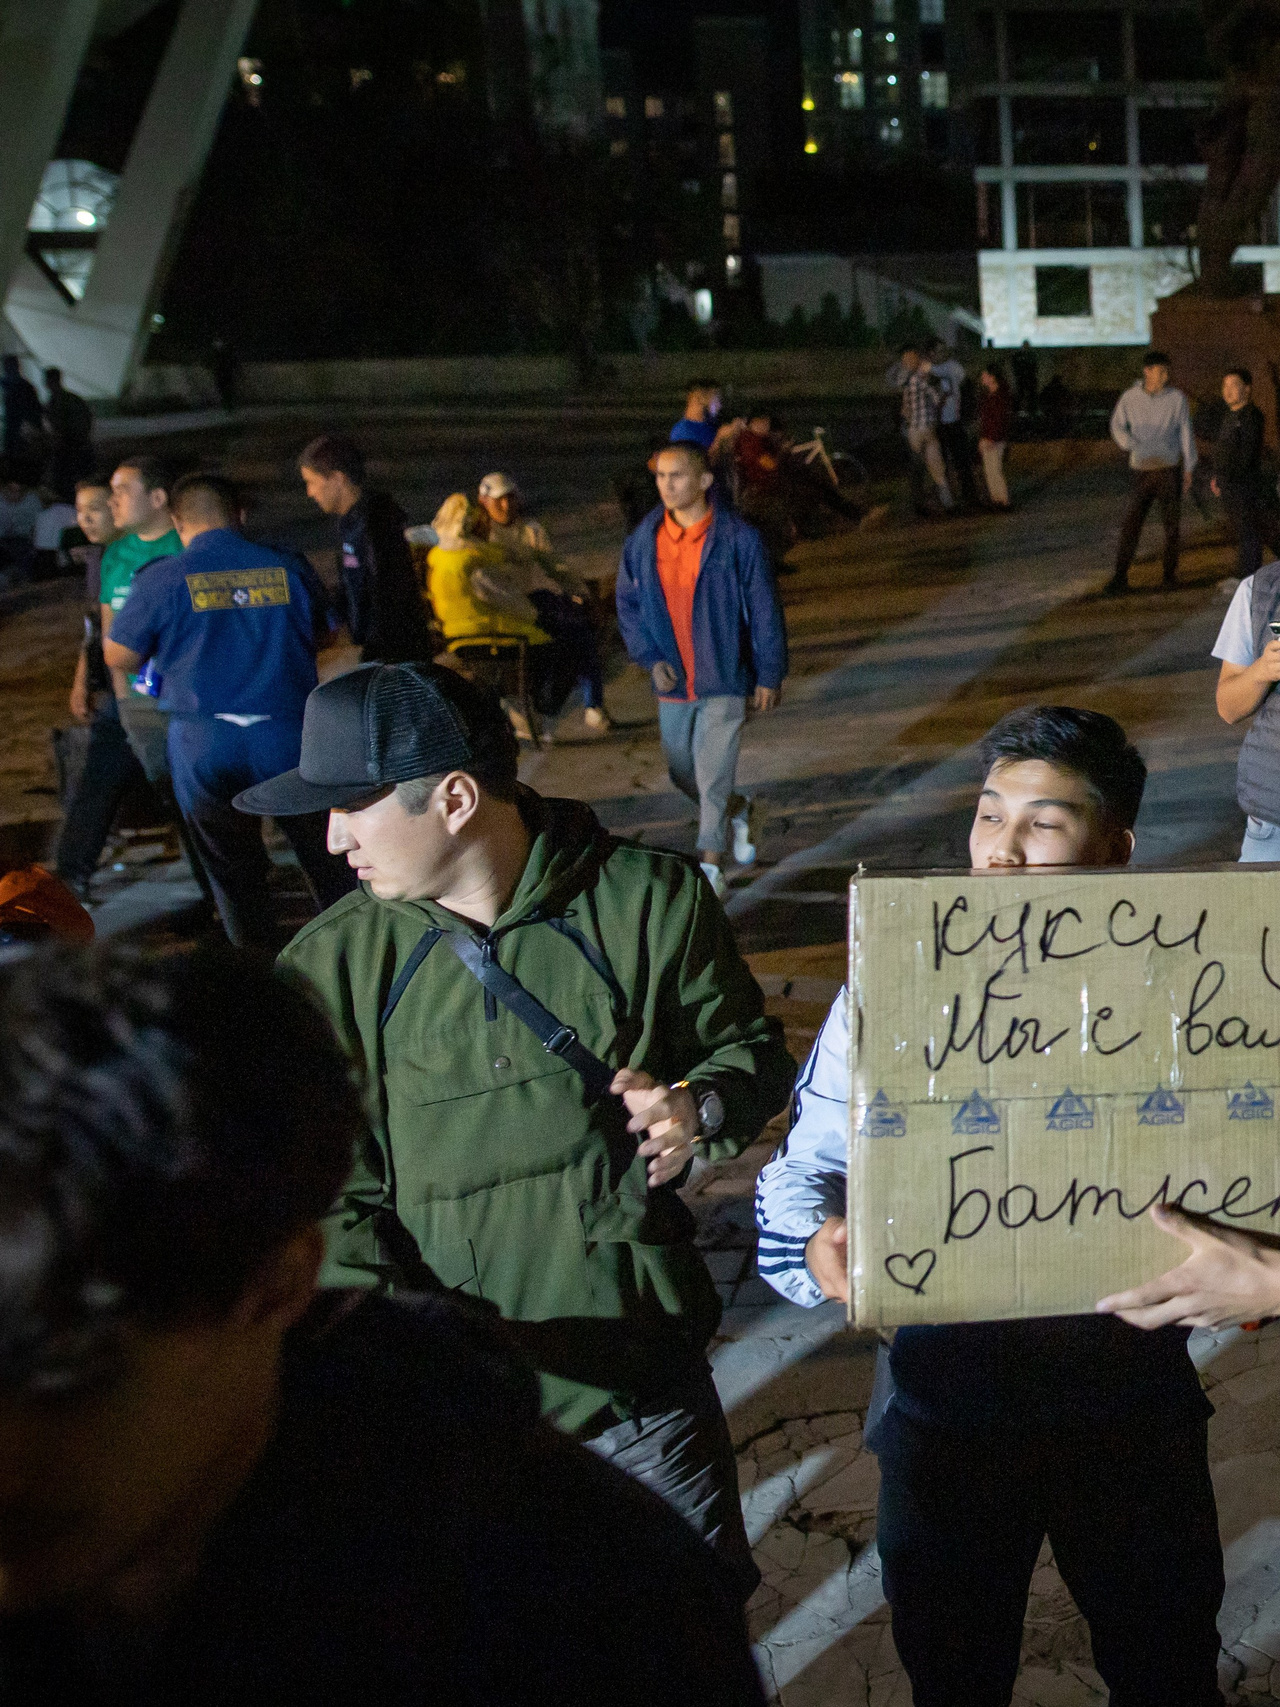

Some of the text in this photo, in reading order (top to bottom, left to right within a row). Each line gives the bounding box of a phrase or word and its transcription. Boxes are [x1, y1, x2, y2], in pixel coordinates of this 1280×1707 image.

[924, 969, 1070, 1071] Мы
[952, 1123, 1000, 1135] AGIO
[1046, 1118, 1094, 1131] AGIO
[1137, 1113, 1185, 1126] AGIO
[1229, 1108, 1274, 1120] AGIO
